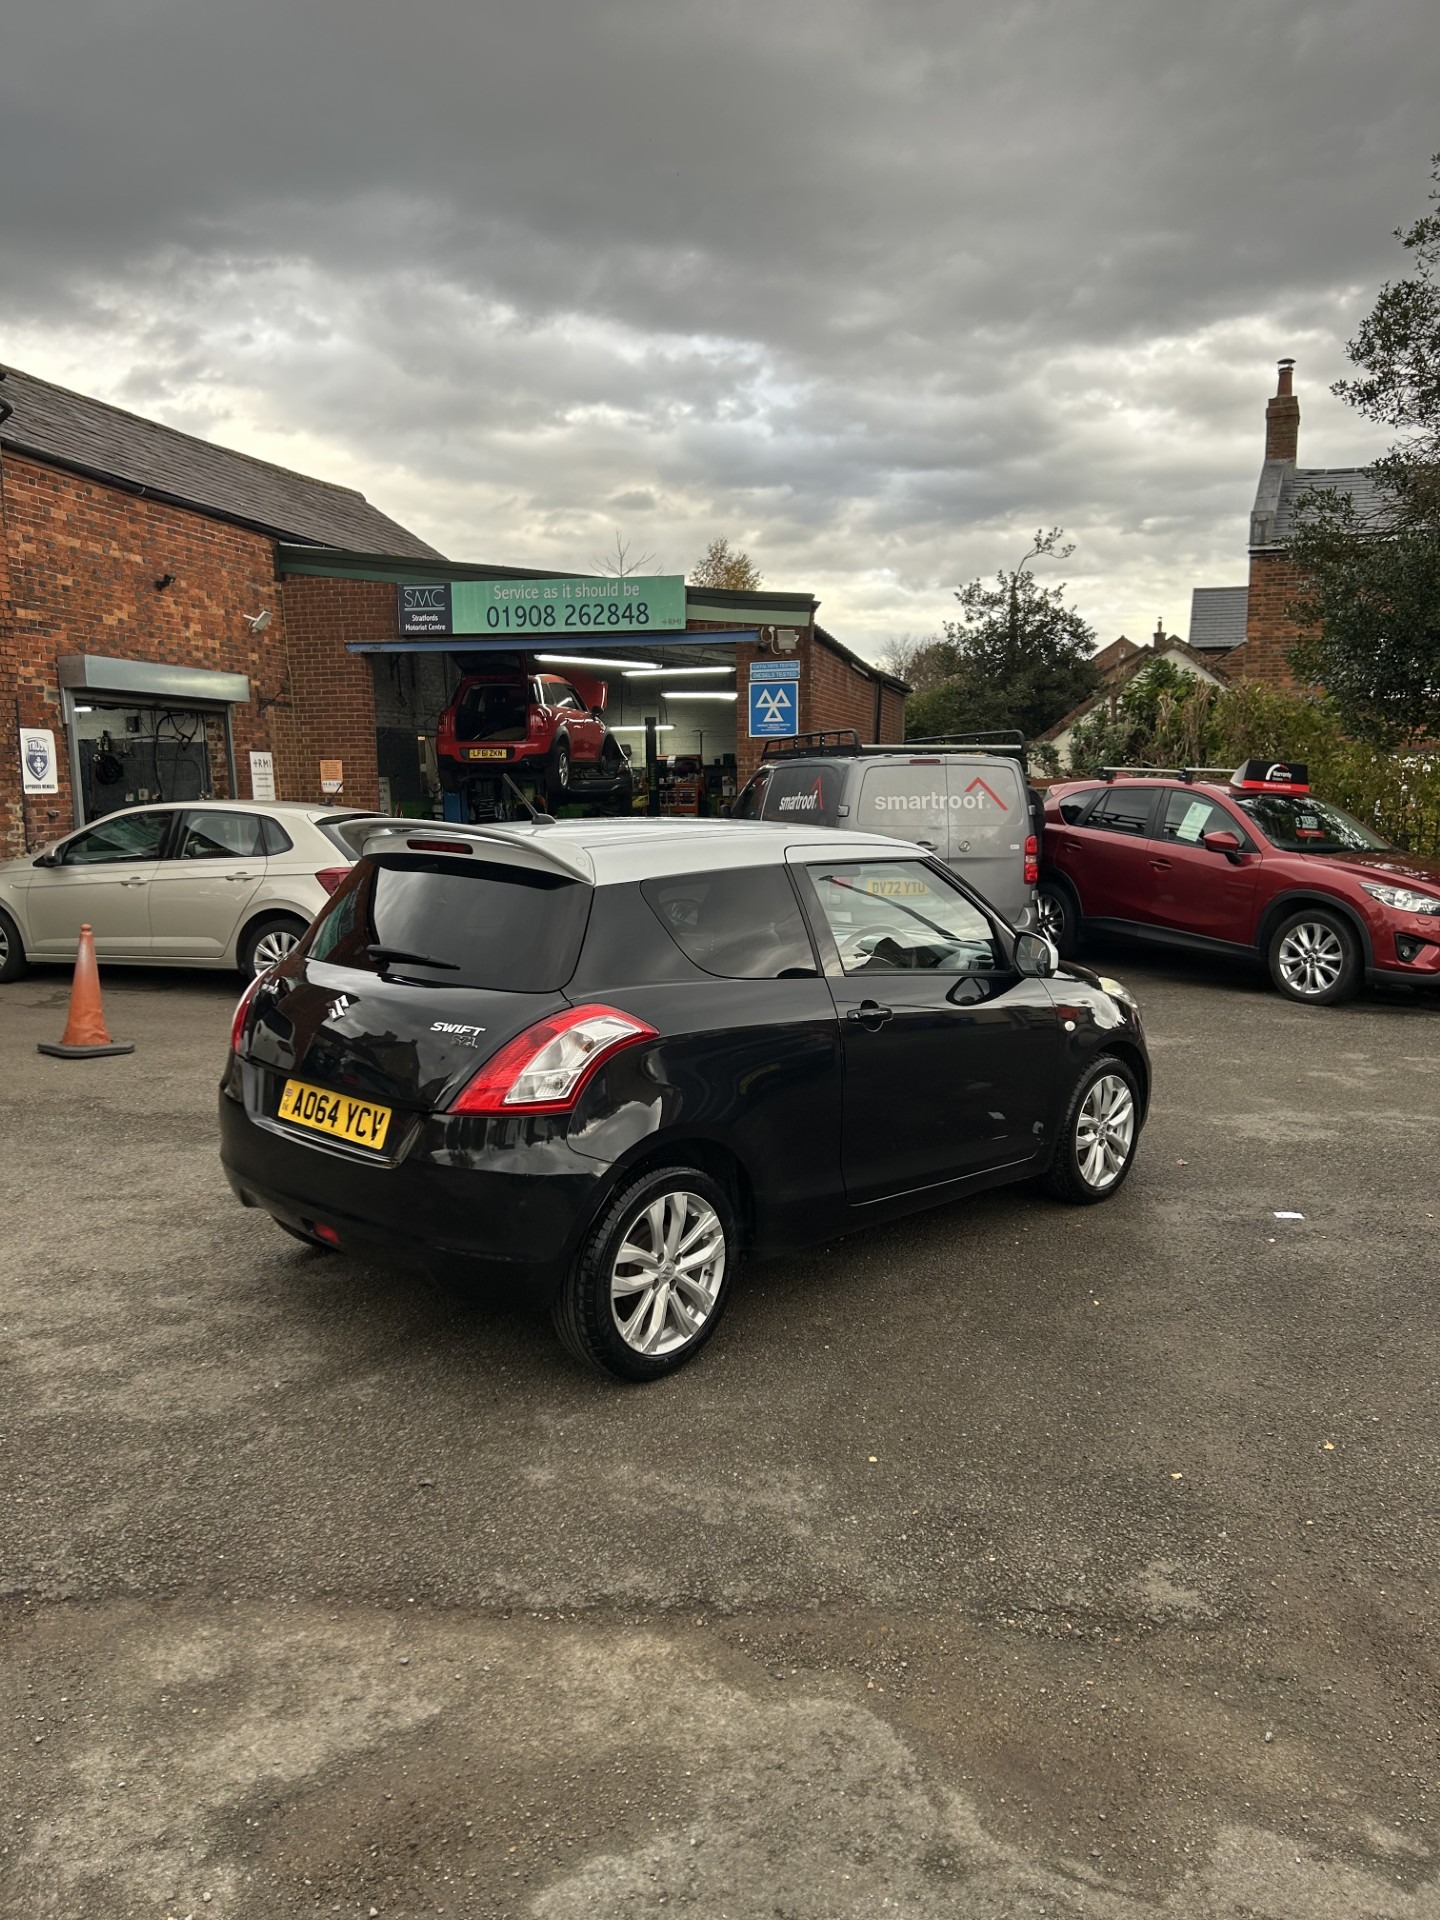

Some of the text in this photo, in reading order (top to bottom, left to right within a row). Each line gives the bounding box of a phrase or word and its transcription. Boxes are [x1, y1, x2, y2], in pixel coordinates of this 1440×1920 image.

[493, 581, 640, 600] Service as it should be
[404, 589, 445, 608] SMC
[411, 613, 439, 622] Stratfords
[486, 602, 650, 628] 01908 262848
[405, 623, 446, 631] Motorist Centre
[752, 670, 797, 679] DIESELS TESTED
[489, 749, 503, 757] ZKN
[872, 880, 926, 894] DV72 YTU
[430, 1021, 487, 1037] SWIFT
[345, 1102, 386, 1141] YCV
